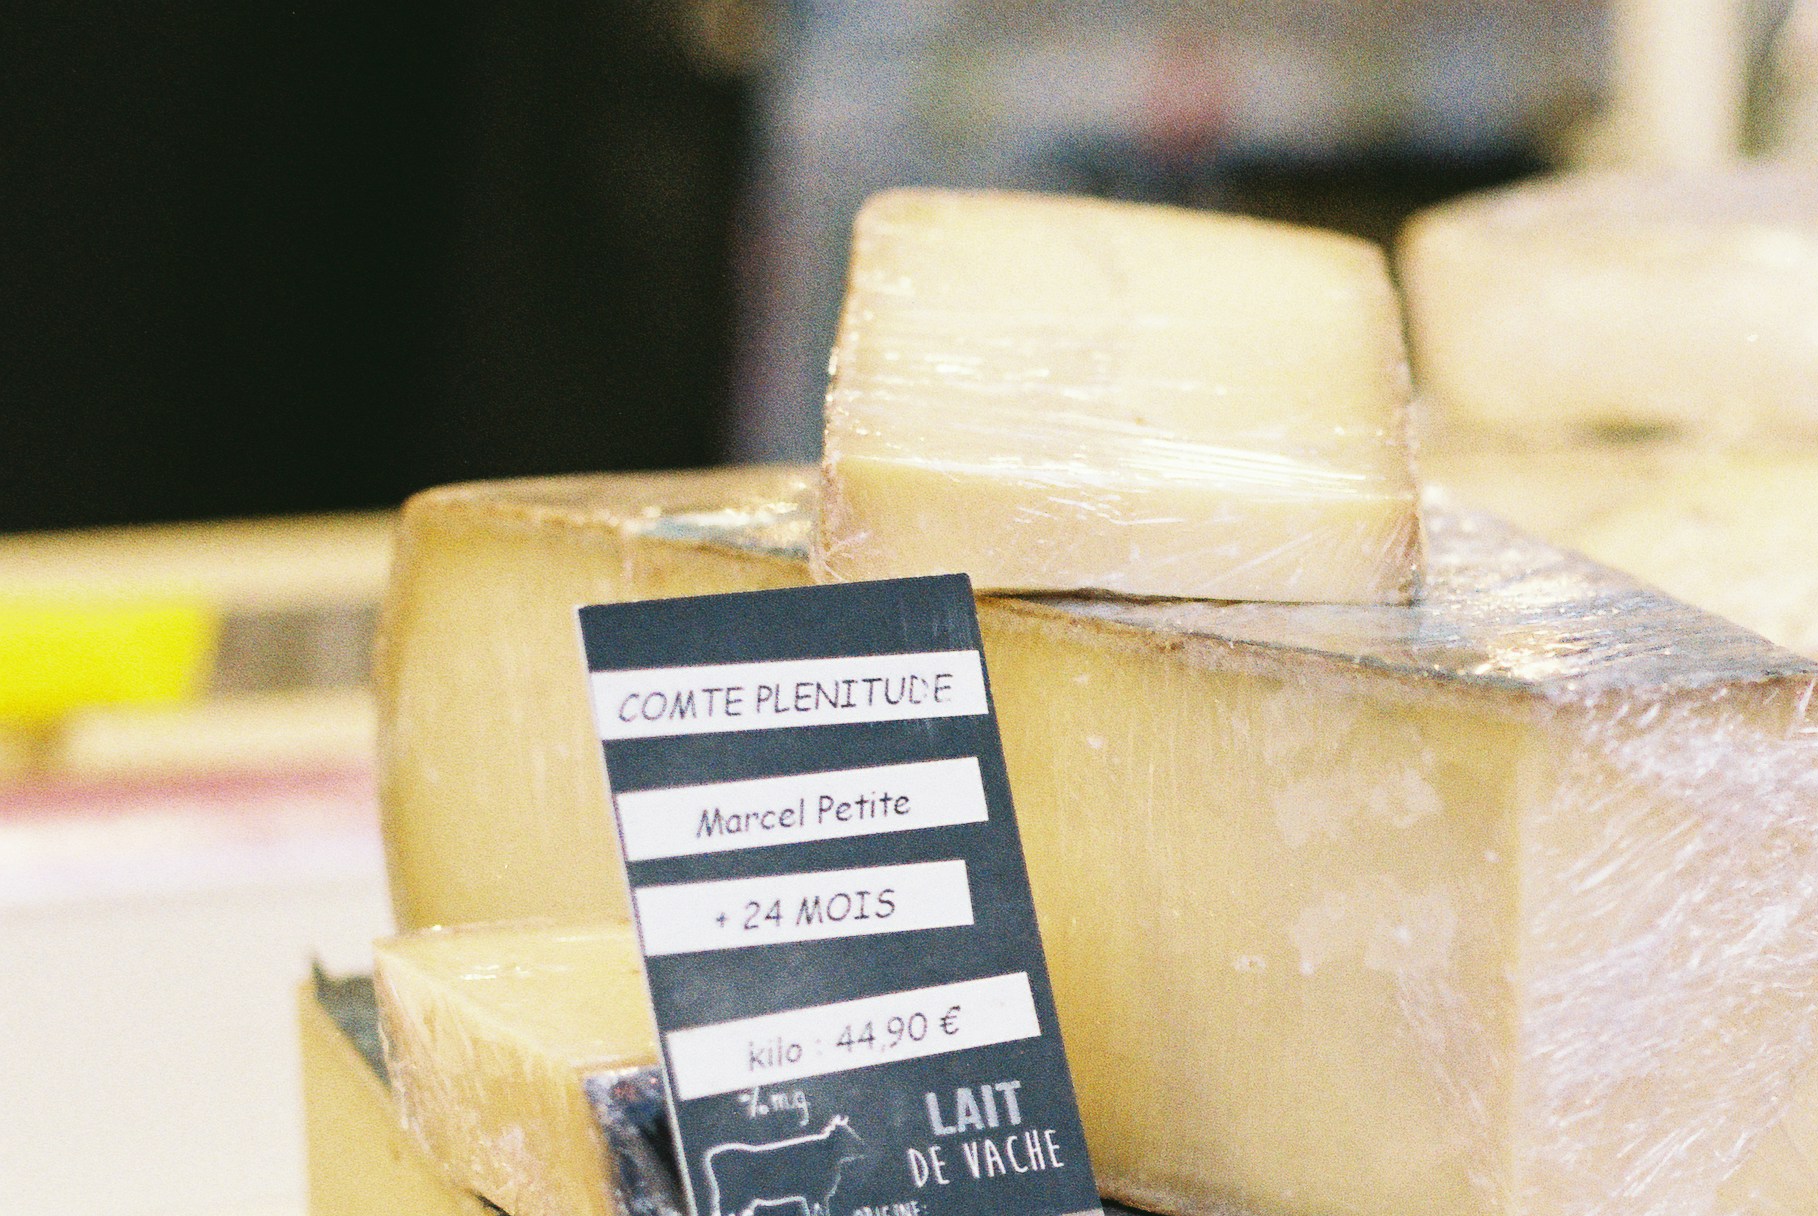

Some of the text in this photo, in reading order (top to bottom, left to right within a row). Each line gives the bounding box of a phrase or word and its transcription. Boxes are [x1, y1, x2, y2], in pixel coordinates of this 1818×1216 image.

[618, 673, 953, 723] COMTE PLENITUDE
[697, 792, 911, 838] Marcel Petite
[714, 888, 897, 931] + 24 MOIS
[747, 1041, 803, 1071] kilo
[836, 1011, 929, 1051] 44,90
[939, 1004, 963, 1037] €
[925, 1080, 1022, 1136] LAIT
[907, 1129, 1065, 1188] DE VACHE
